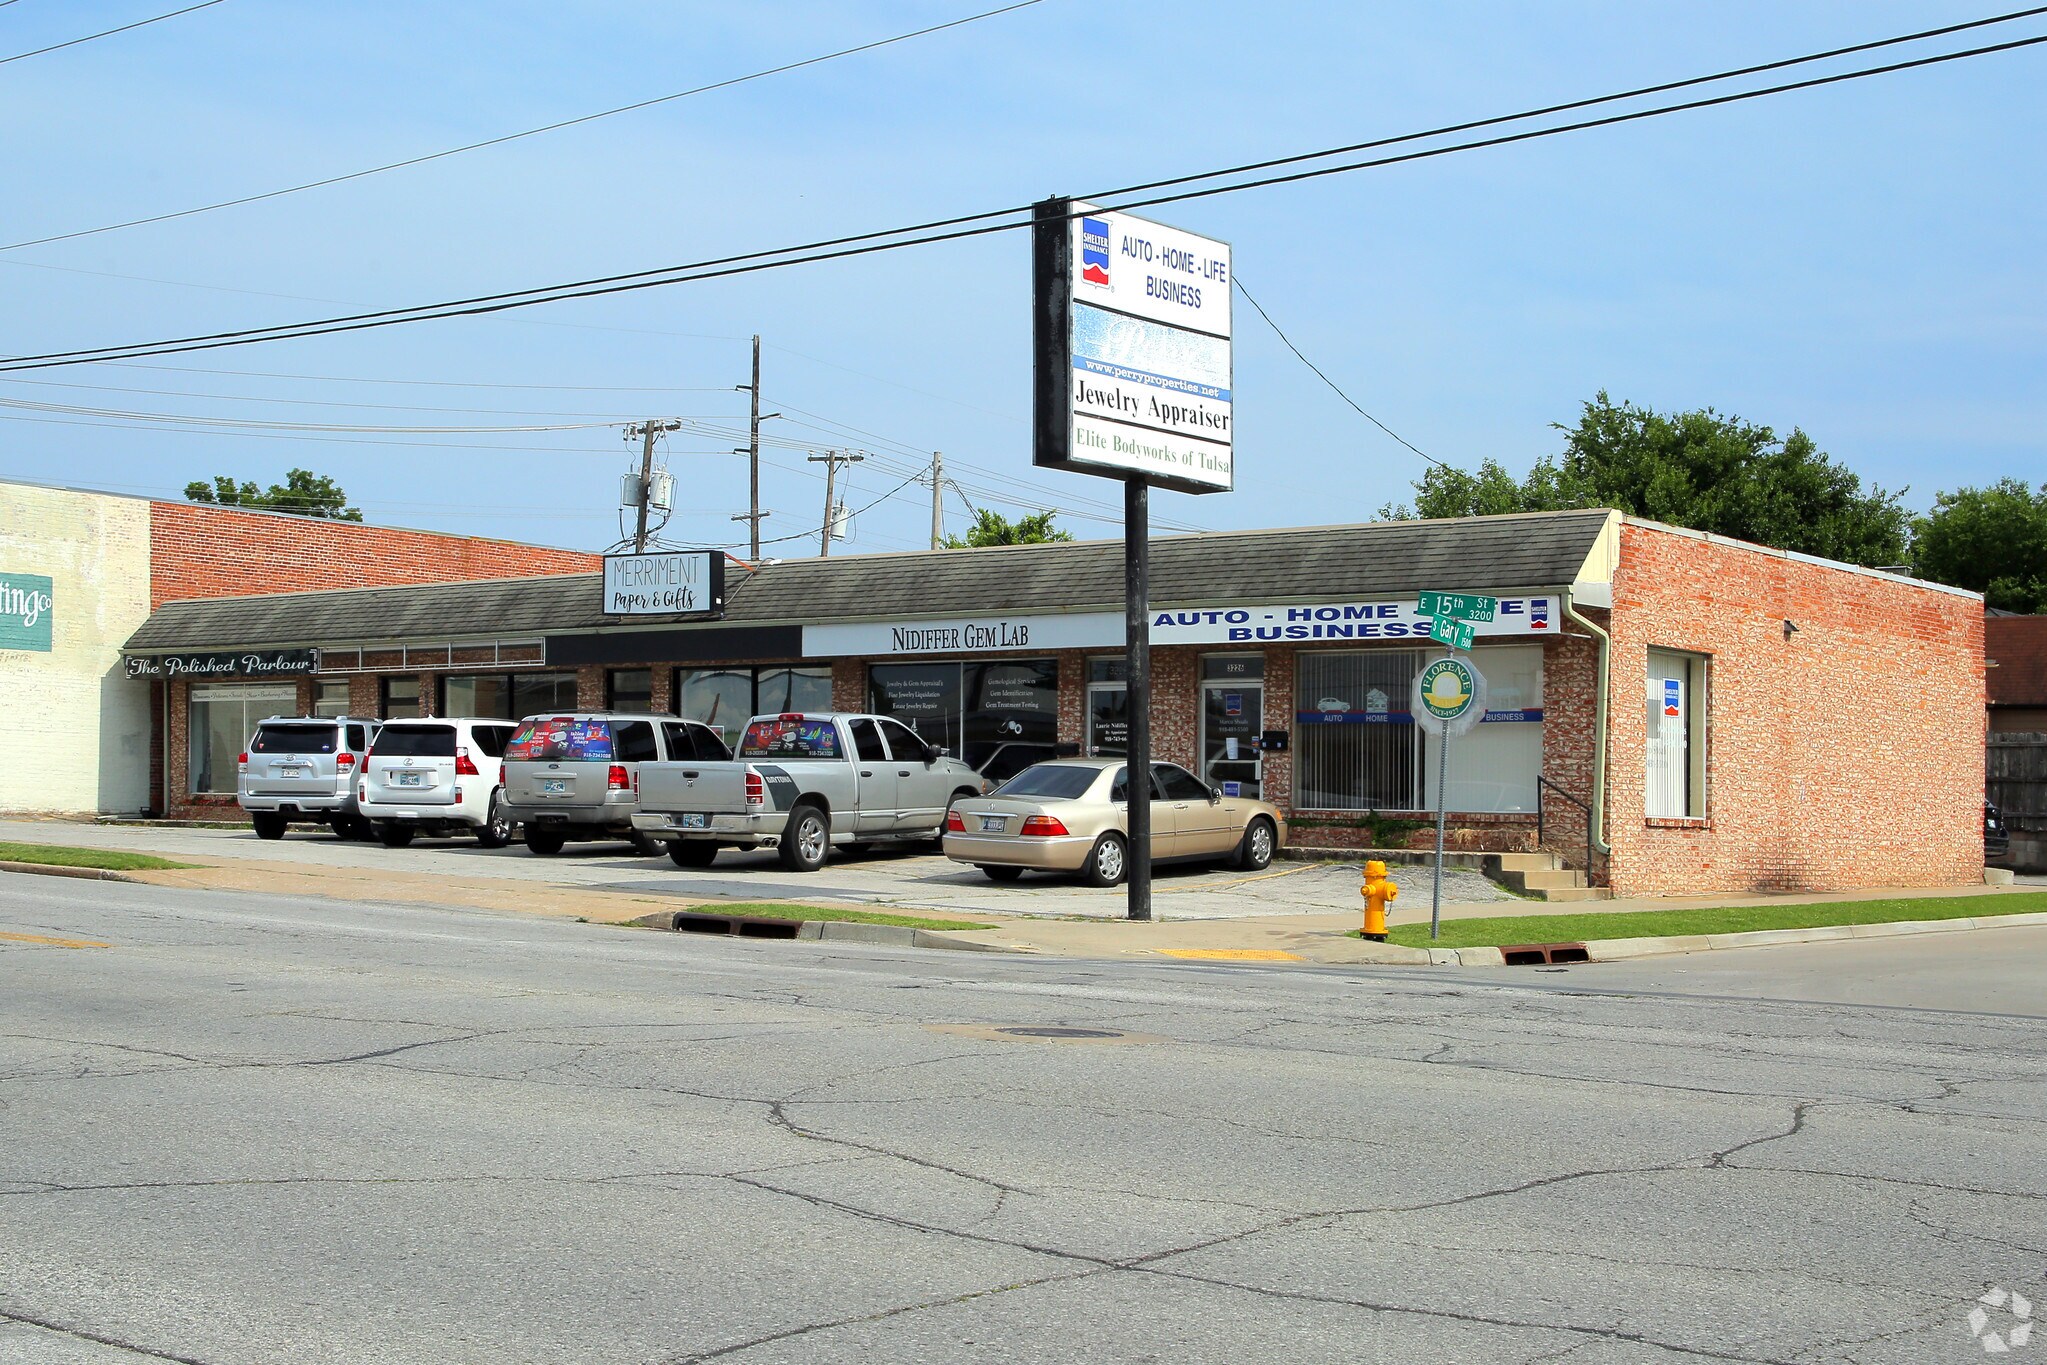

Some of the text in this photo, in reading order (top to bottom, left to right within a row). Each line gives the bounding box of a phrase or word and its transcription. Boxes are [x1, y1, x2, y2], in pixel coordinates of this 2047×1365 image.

[1083, 232, 1108, 247] SHELTER
[1083, 242, 1108, 255] INSURANCE
[1121, 235, 1153, 262] AUTO
[1162, 247, 1194, 275] HOME
[1204, 258, 1226, 283] LIFE
[1146, 275, 1201, 309] BUSINESS
[1085, 360, 1219, 398] www.perryproperties.net
[1075, 379, 1229, 431] Jewelry Appraiser
[1076, 428, 1229, 474] Elite Bodyworks of Tulsa
[613, 556, 699, 587] MERRIMENT
[613, 585, 697, 612] Paper & Gifts
[1420, 598, 1427, 608] E
[1436, 596, 1464, 614] 15th
[1476, 598, 1488, 608] St
[1153, 610, 1249, 626] AUTO
[1288, 605, 1398, 621] HOME
[1469, 610, 1492, 620] 3200
[892, 622, 1028, 651] NIDIFFER GEM LAB
[1229, 622, 1432, 640] BUSINESS
[1433, 620, 1471, 645] S Gary Pl
[1461, 637, 1471, 648] 1500
[128, 654, 310, 675] The Polished Parlour
[1423, 662, 1471, 690] FLORENCE
[915, 691, 940, 699] Liquidation
[1021, 701, 1039, 709] Testing
[1485, 713, 1524, 721] BUSINESS
